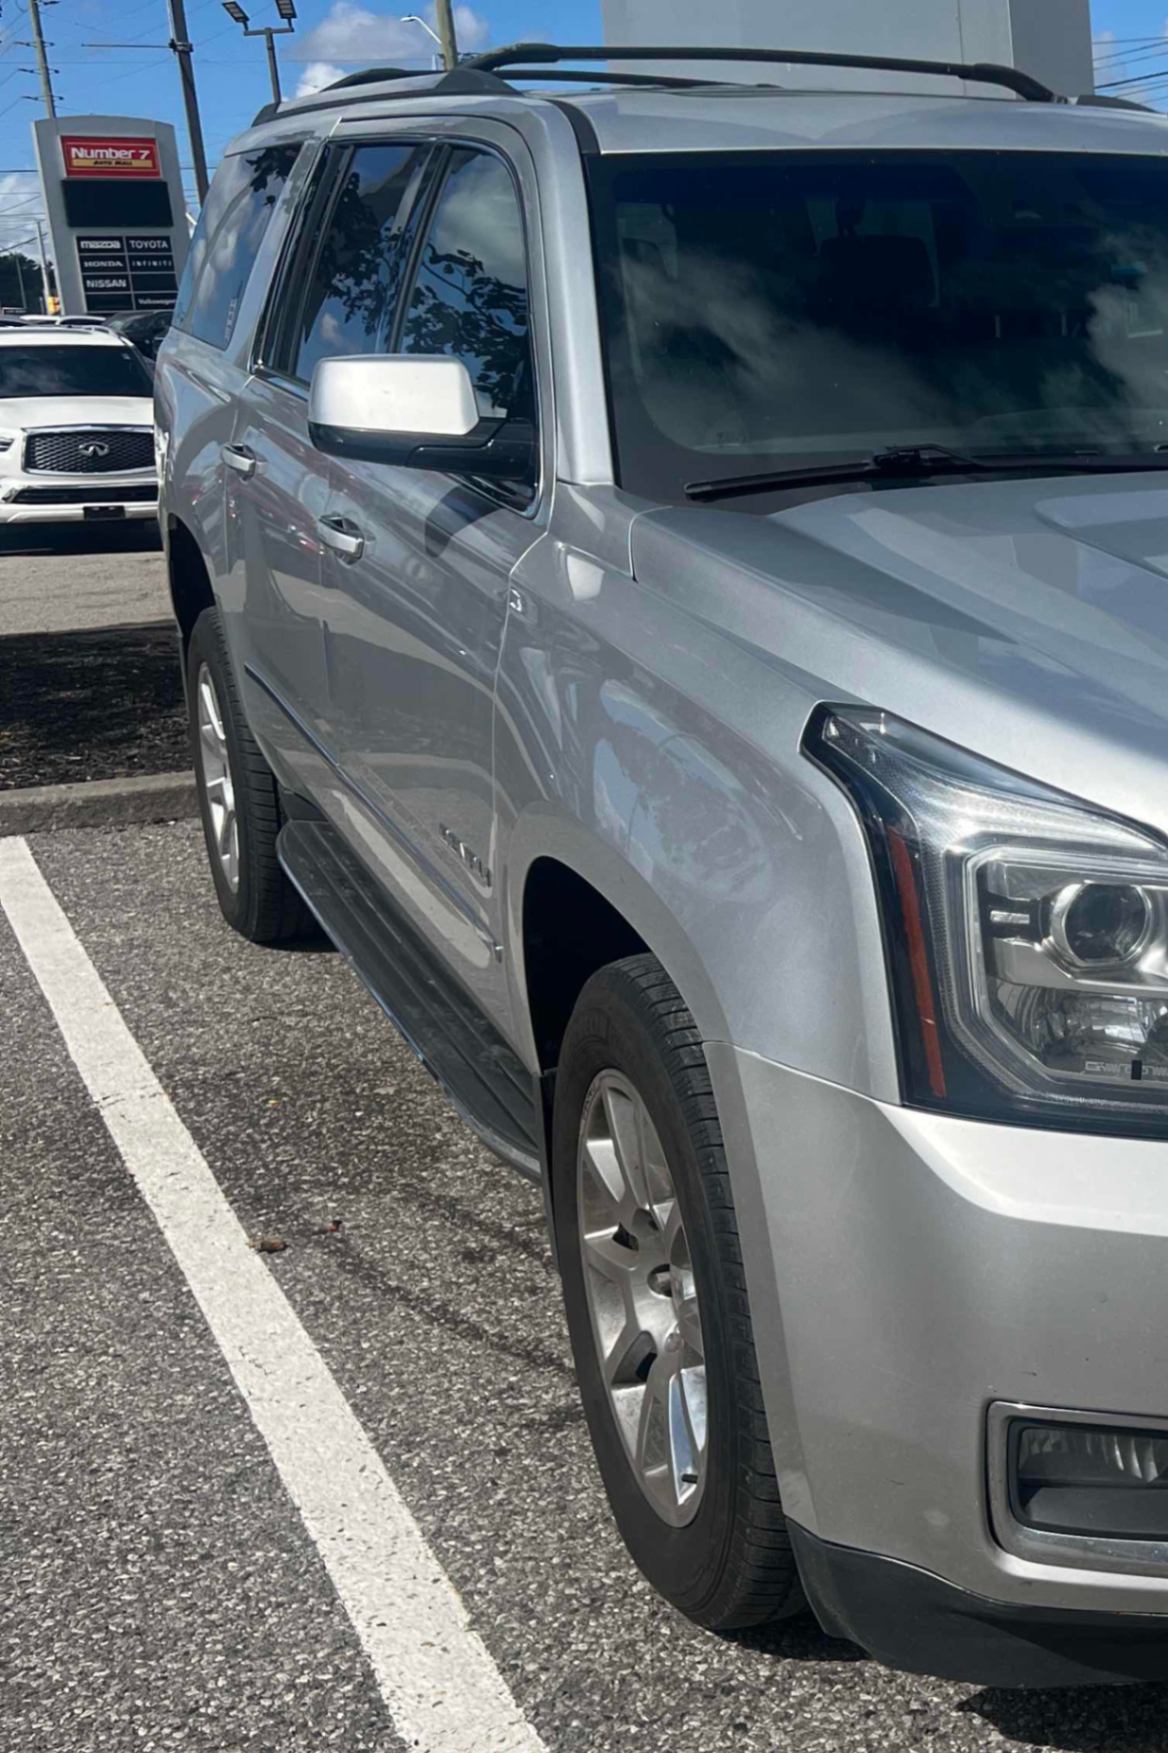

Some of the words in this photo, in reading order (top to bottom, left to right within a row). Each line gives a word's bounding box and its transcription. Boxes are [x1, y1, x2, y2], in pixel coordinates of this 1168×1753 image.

[71, 147, 135, 159] Number
[139, 150, 150, 160] 7
[129, 240, 169, 249] TOYOTA
[86, 280, 127, 288] NISSAN
